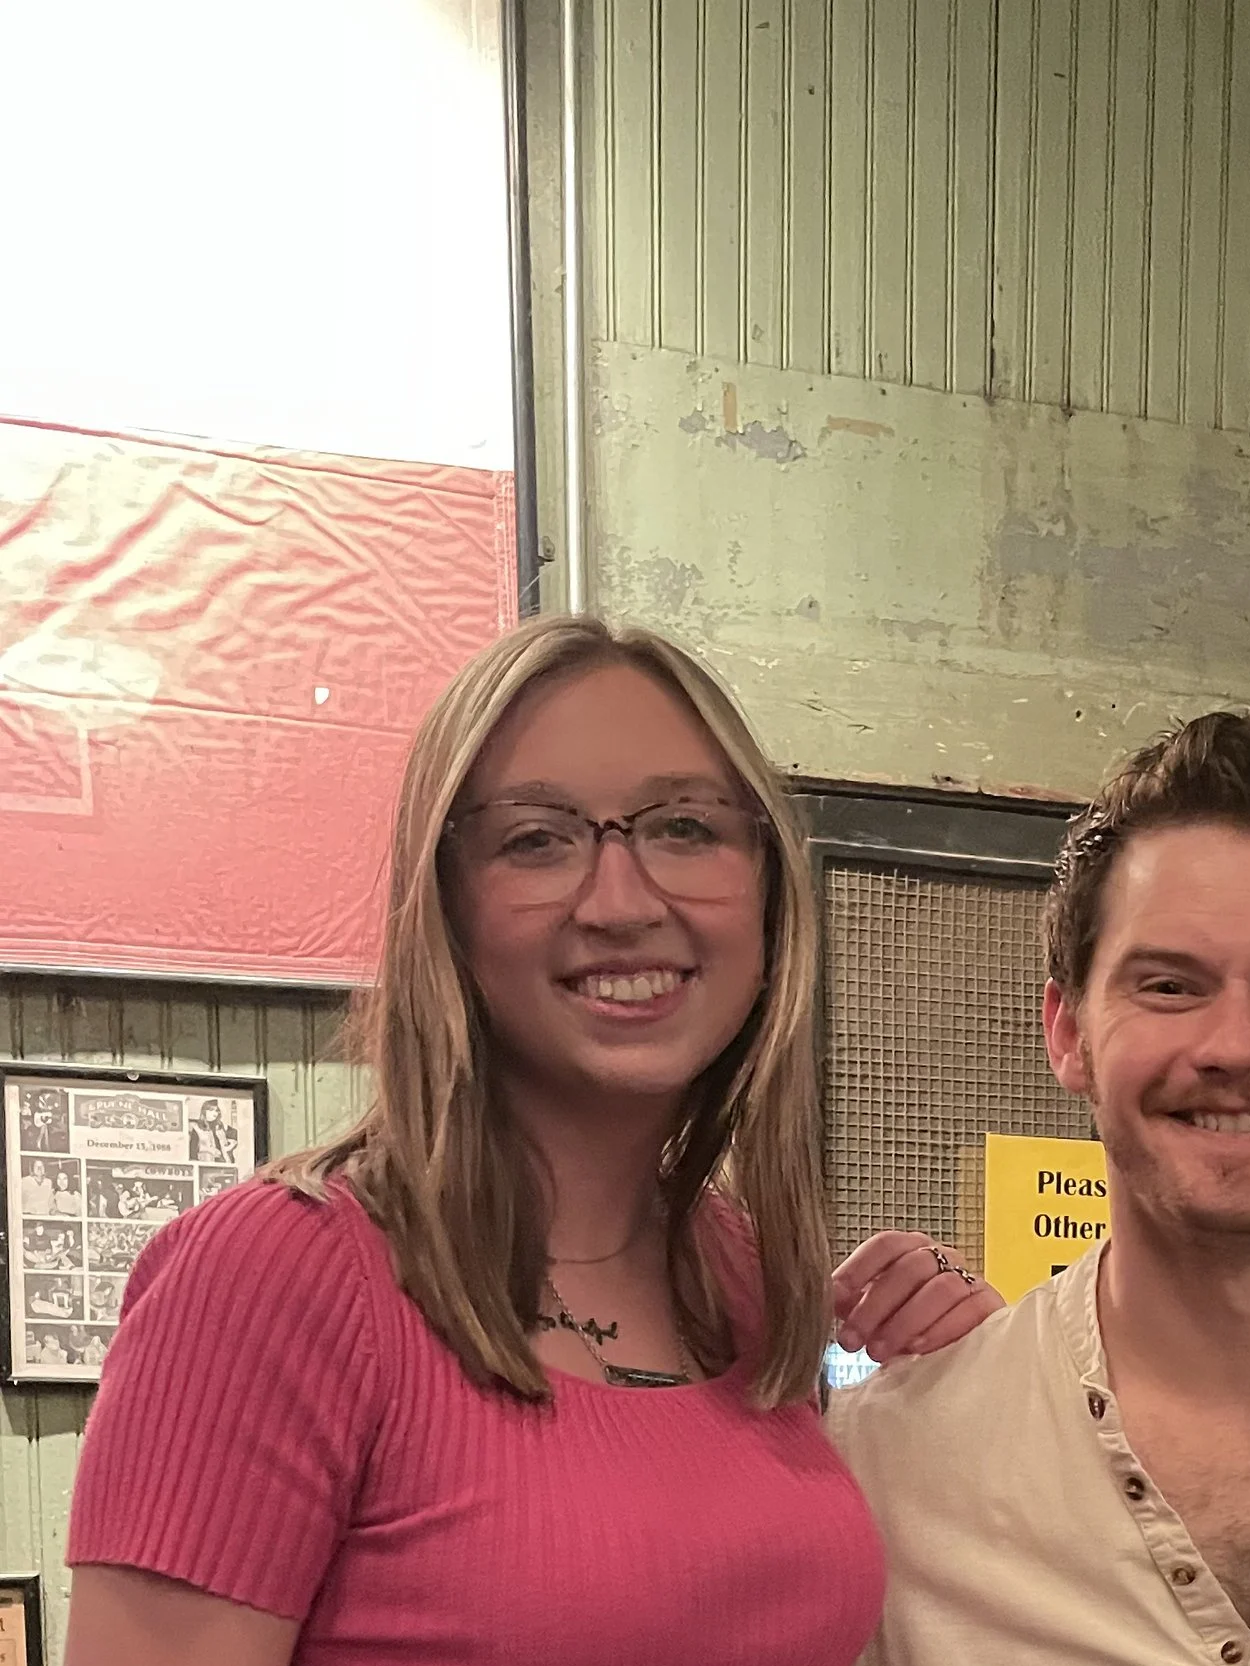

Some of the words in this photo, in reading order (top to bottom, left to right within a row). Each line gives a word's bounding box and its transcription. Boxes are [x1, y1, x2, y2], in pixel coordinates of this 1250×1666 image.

[87, 1139, 133, 1151] December
[1037, 1170, 1107, 1198] Pleas
[1034, 1213, 1106, 1240] Other
